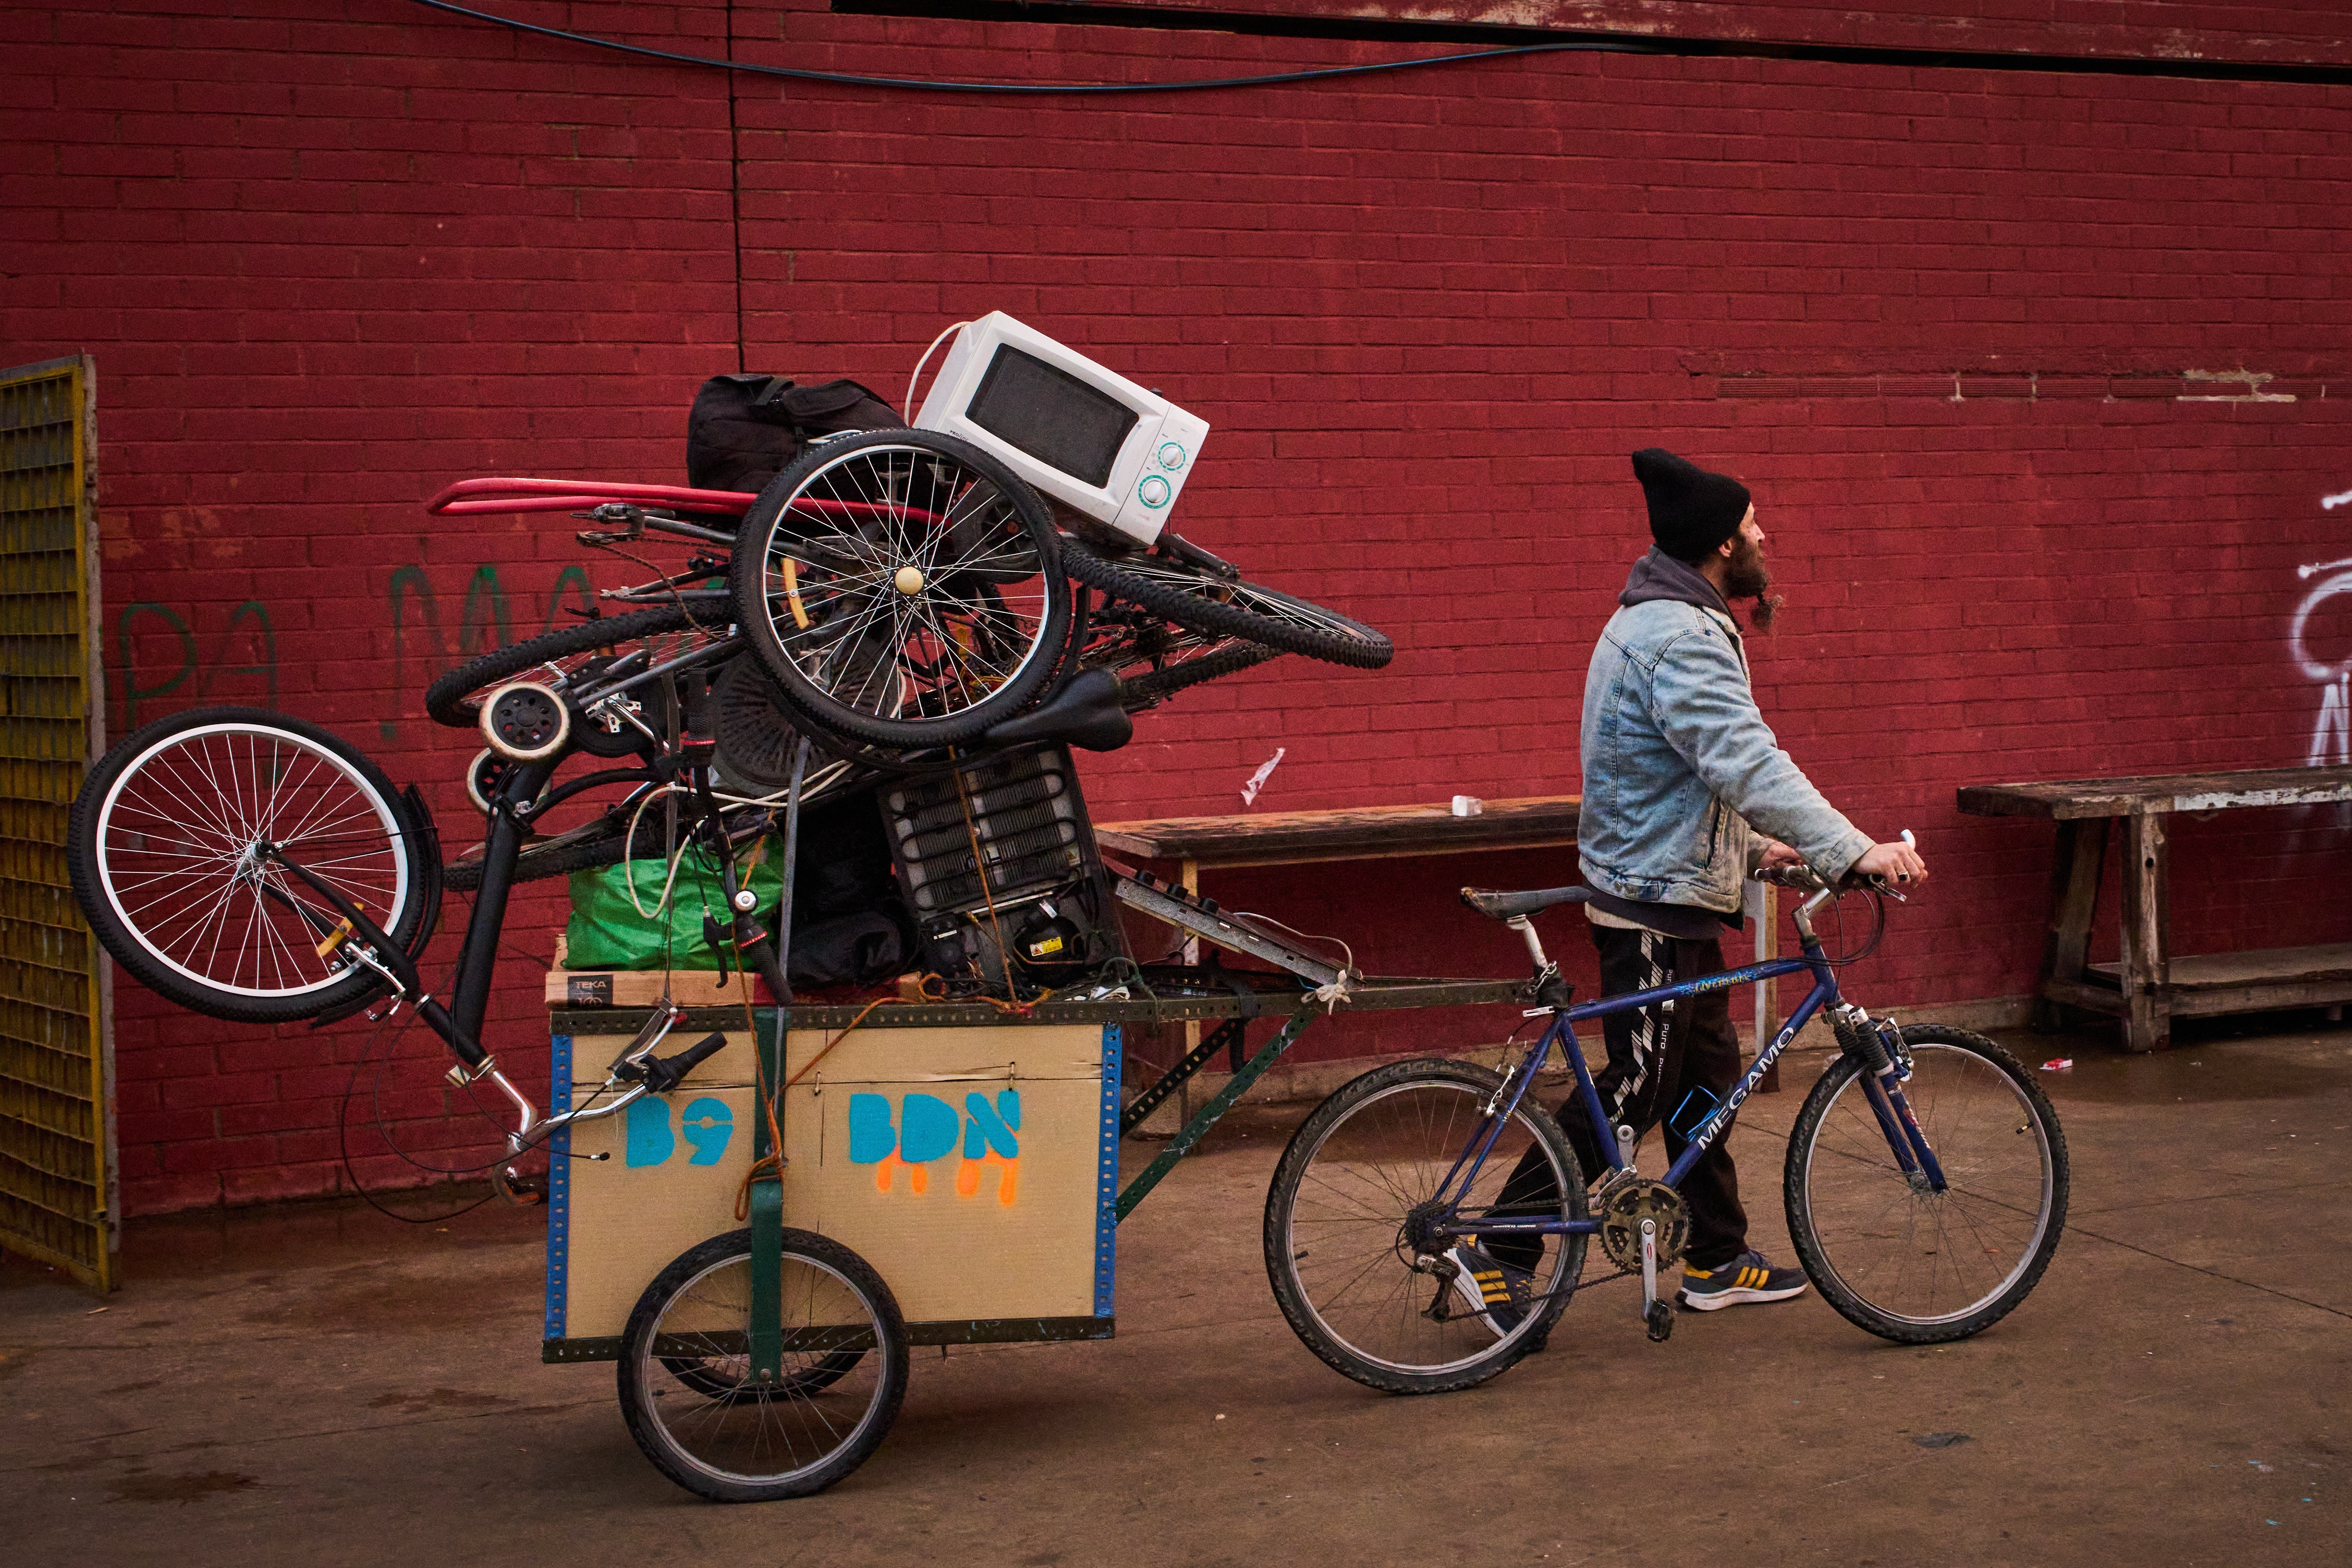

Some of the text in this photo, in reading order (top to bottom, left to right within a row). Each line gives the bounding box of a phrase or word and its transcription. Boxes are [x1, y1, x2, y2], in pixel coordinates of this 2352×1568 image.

[574, 980, 607, 989] TEKA
[1660, 1023, 1670, 1049] Puro
[1697, 1027, 1794, 1150] MEGAMO
[626, 1090, 1020, 1167] B9 BDN
